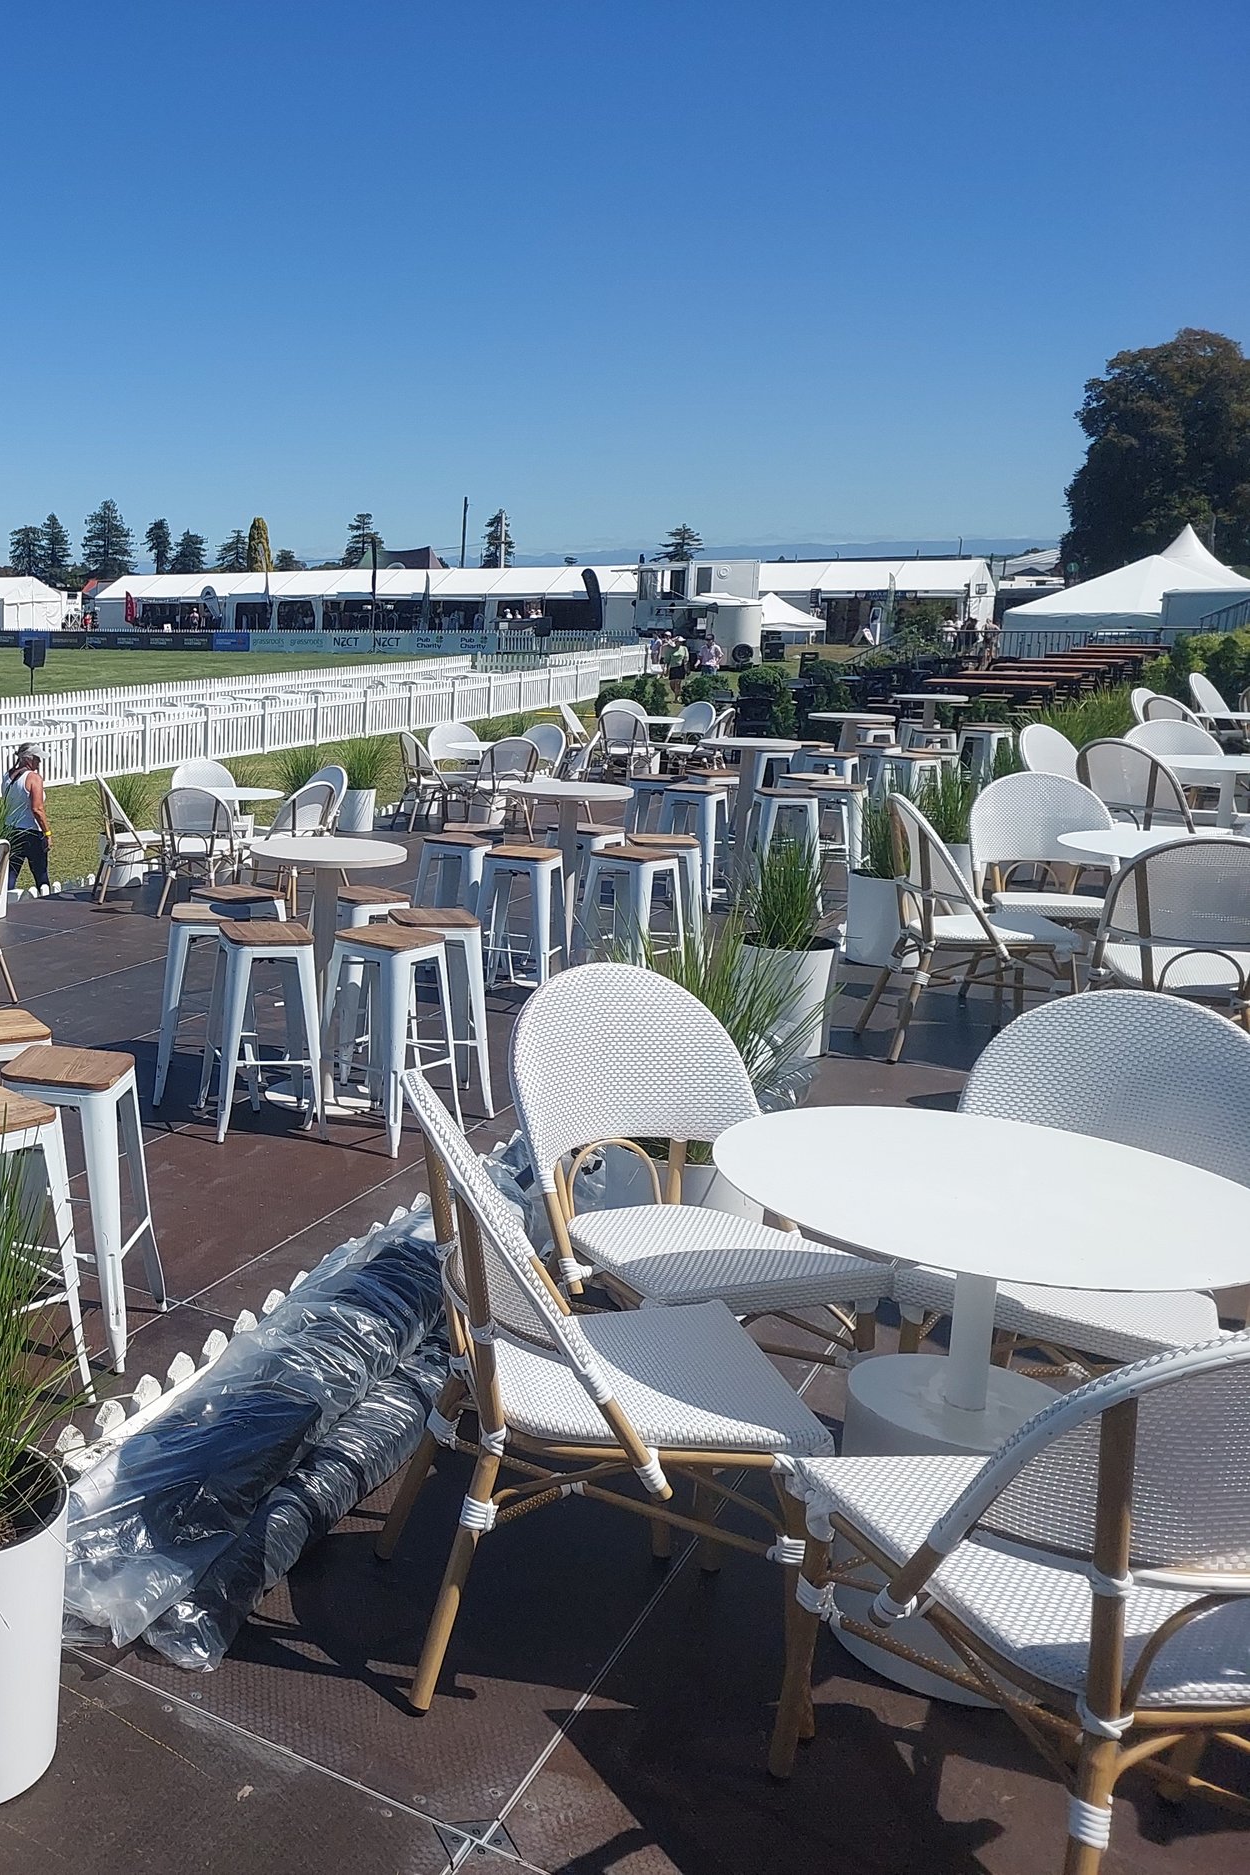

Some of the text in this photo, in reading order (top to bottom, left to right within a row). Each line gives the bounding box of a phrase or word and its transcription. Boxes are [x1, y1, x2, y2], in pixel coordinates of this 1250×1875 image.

[333, 637, 359, 647] NZCT
[375, 637, 401, 647] NZCT
[416, 642, 442, 650] Charity
